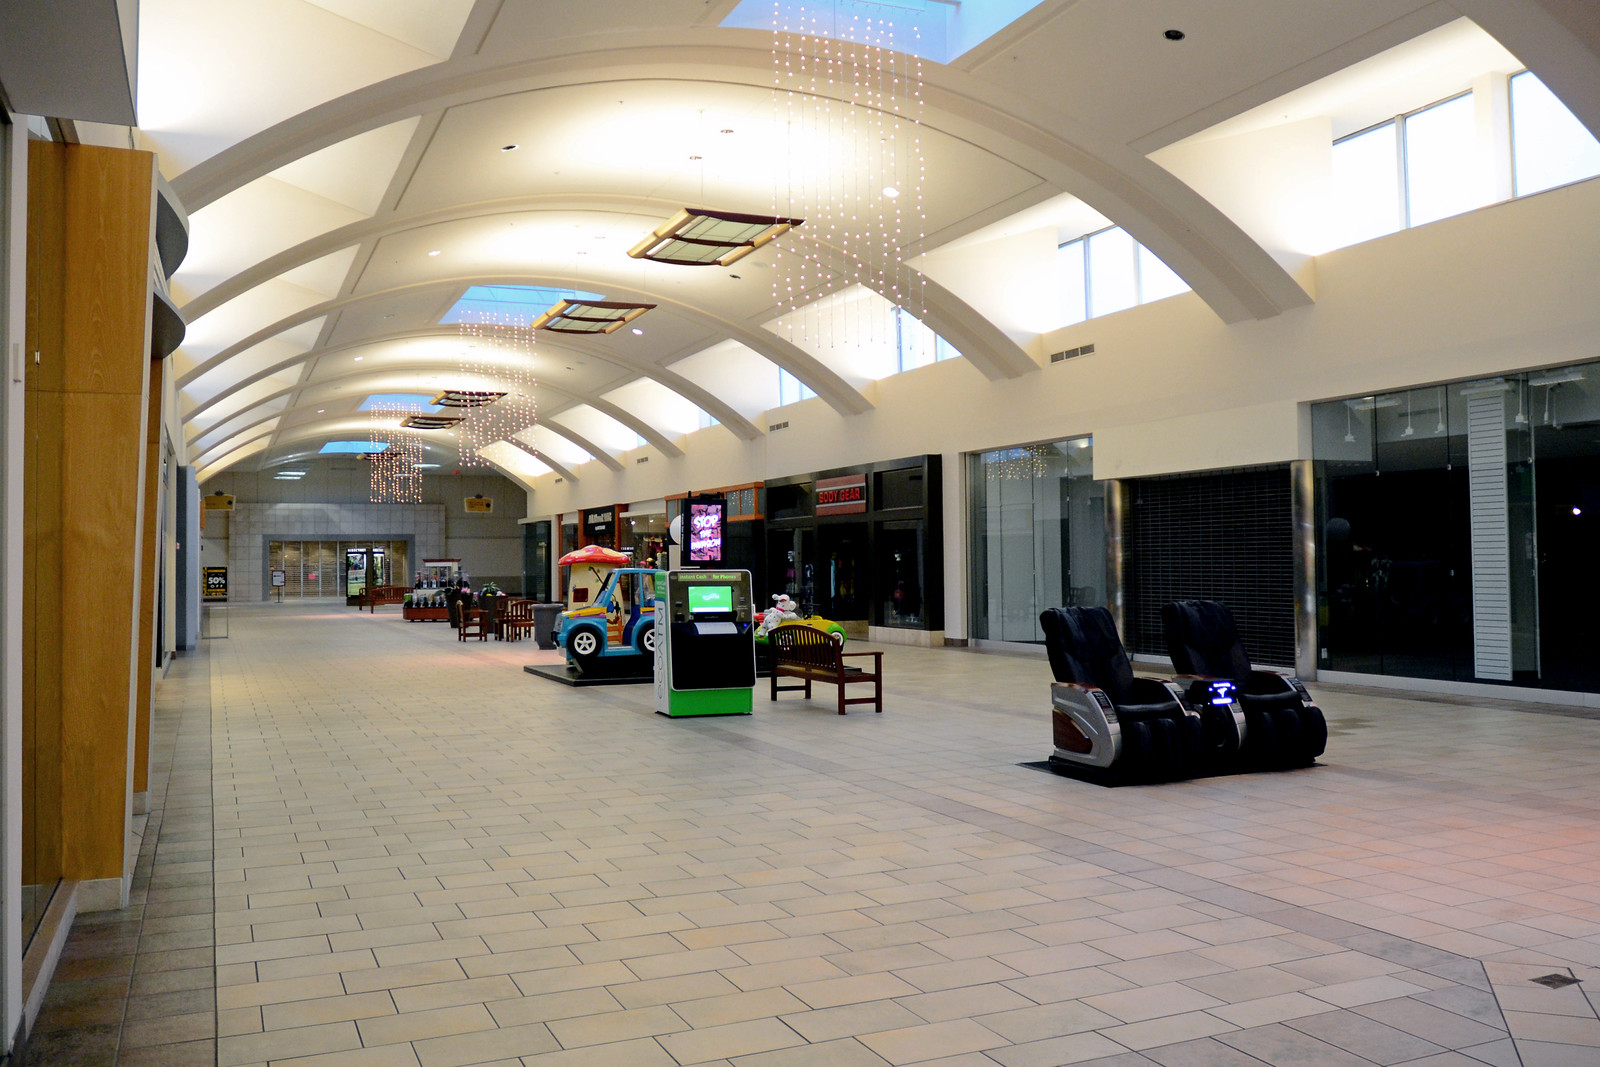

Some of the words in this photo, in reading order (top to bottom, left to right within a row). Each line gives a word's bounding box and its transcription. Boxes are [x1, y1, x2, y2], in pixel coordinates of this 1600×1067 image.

[819, 491, 838, 504] BODY
[840, 488, 860, 501] GEAR
[693, 514, 718, 528] STOP
